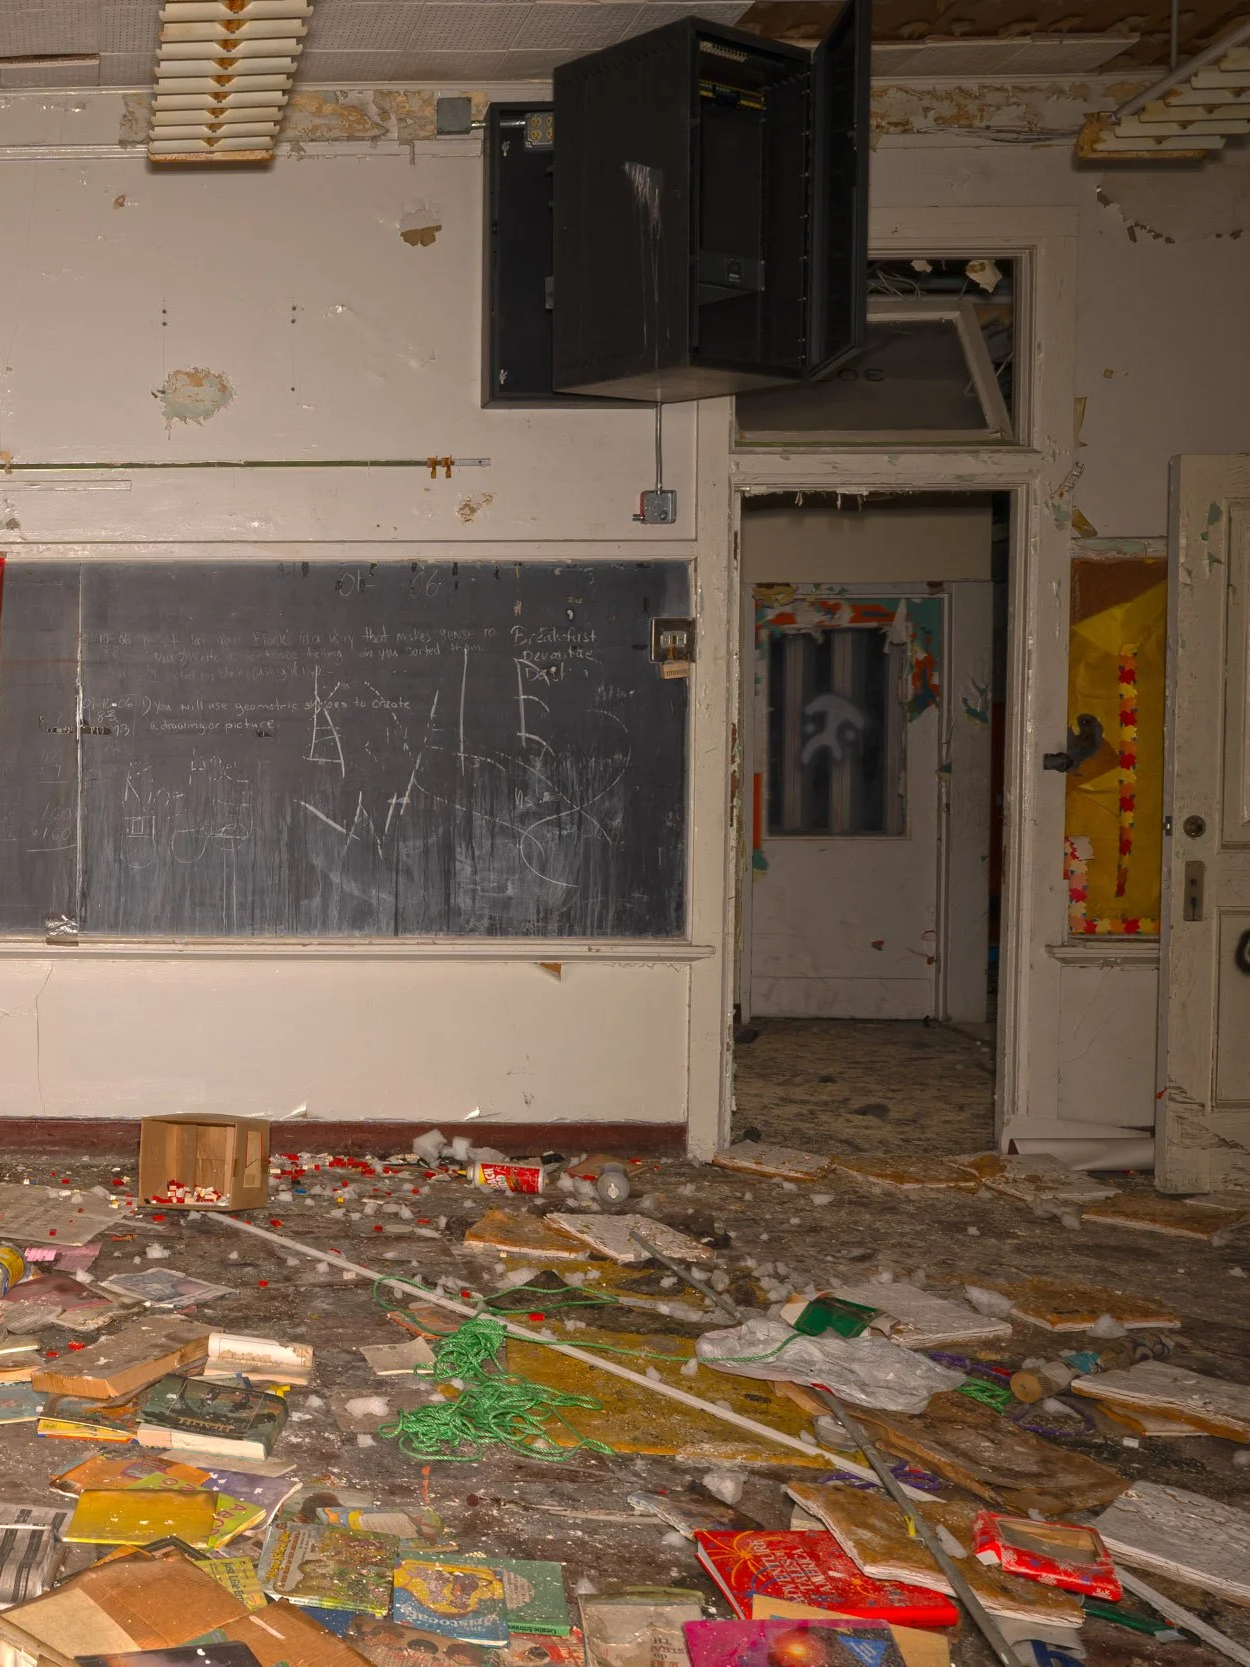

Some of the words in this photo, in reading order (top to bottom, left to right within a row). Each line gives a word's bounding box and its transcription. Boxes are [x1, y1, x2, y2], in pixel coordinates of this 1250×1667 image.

[181, 699, 204, 711] will
[208, 702, 228, 711] use
[234, 698, 298, 717] geometric
[353, 697, 367, 708] to
